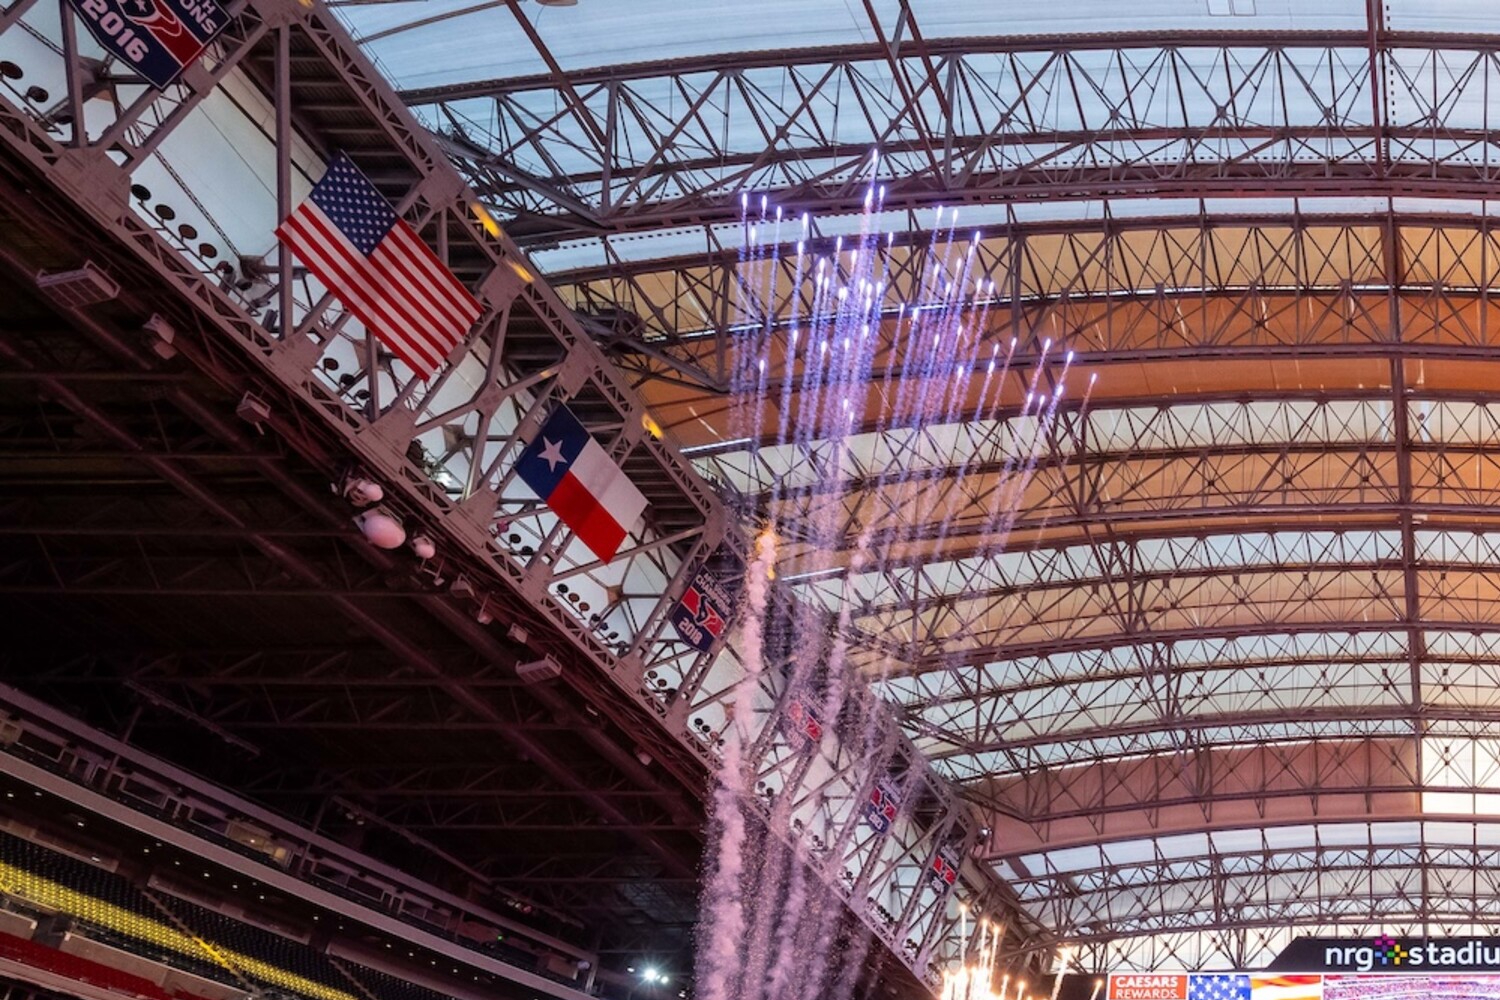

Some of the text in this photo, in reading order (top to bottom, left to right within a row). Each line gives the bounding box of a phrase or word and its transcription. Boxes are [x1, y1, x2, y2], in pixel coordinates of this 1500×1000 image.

[81, 0, 149, 63] 2016
[1325, 944, 1373, 971] nrg
[1115, 976, 1178, 988] CAESARS
